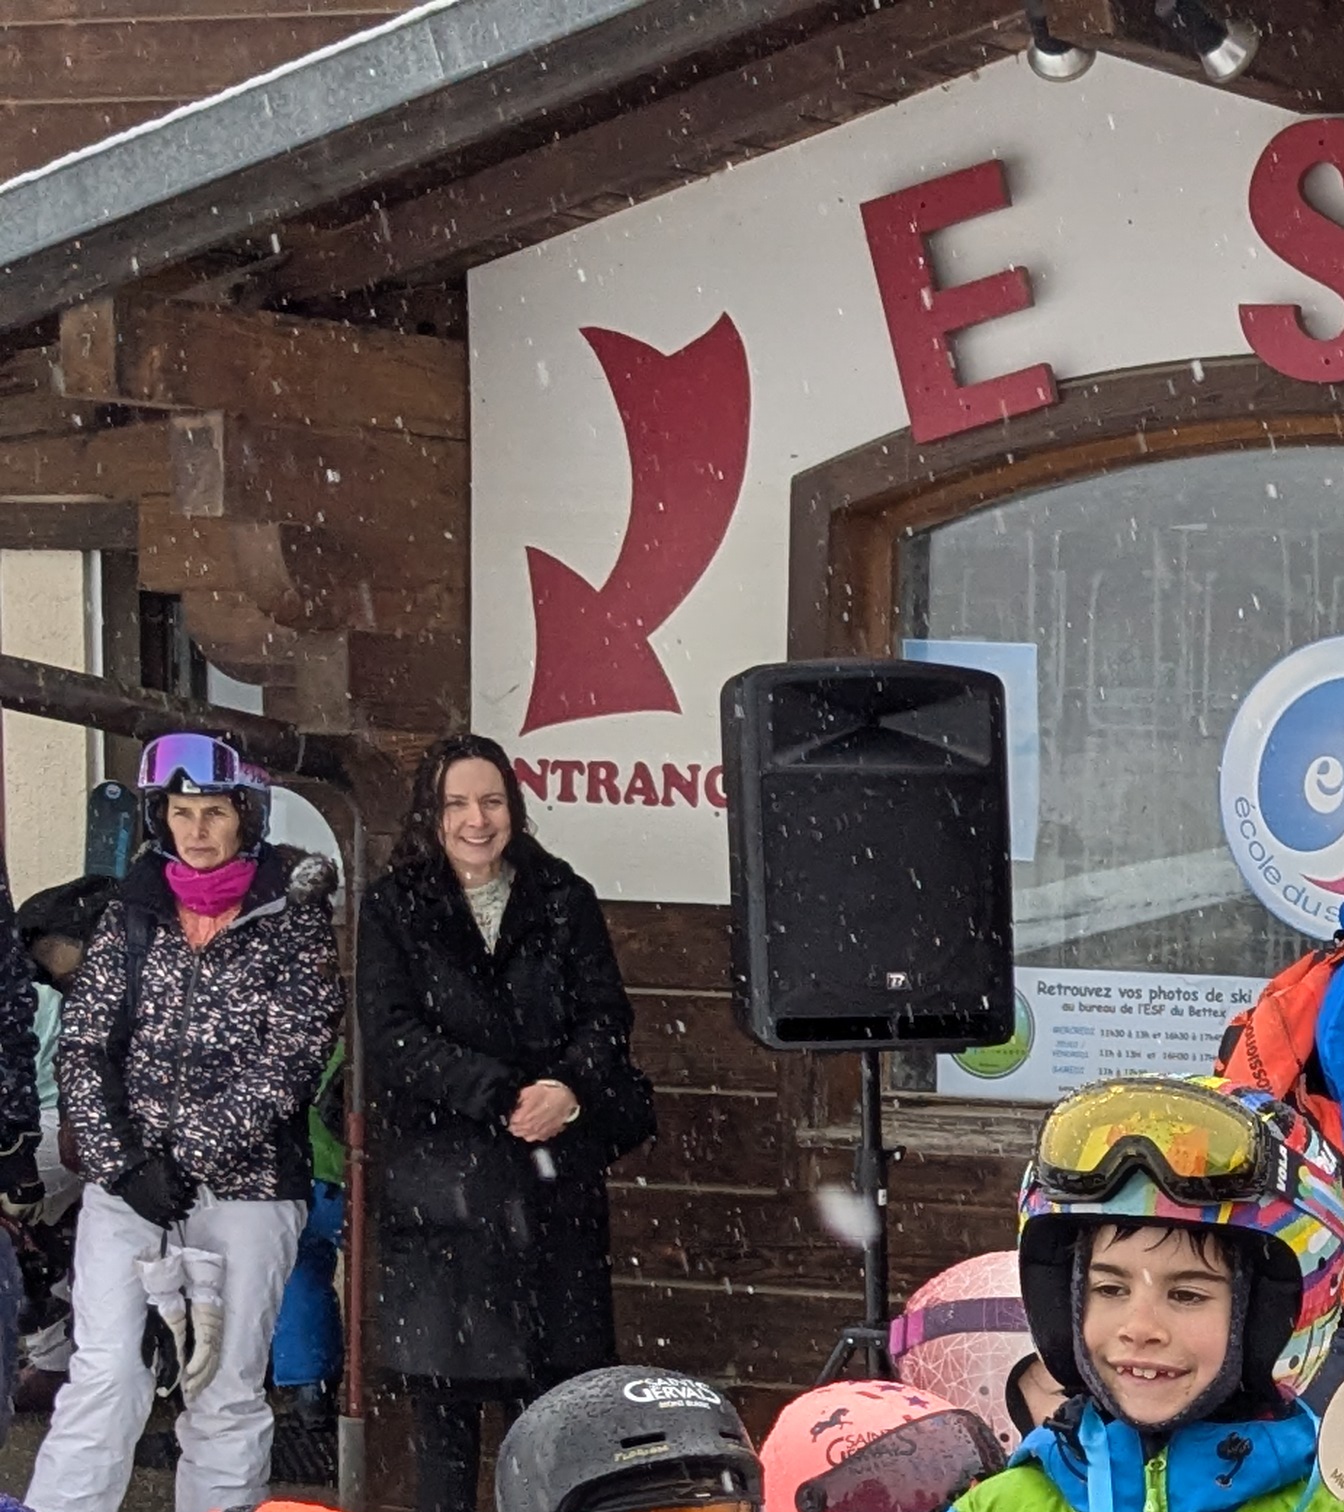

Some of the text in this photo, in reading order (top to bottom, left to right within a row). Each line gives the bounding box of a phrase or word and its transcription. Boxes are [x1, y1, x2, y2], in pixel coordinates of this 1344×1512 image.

[514, 757, 728, 808] NTRANC
[1037, 980, 1253, 1005] Retrouvez vos photos de ski
[1079, 1001, 1116, 1013] bureau
[1120, 1003, 1134, 1015] de
[1170, 1005, 1184, 1016] du
